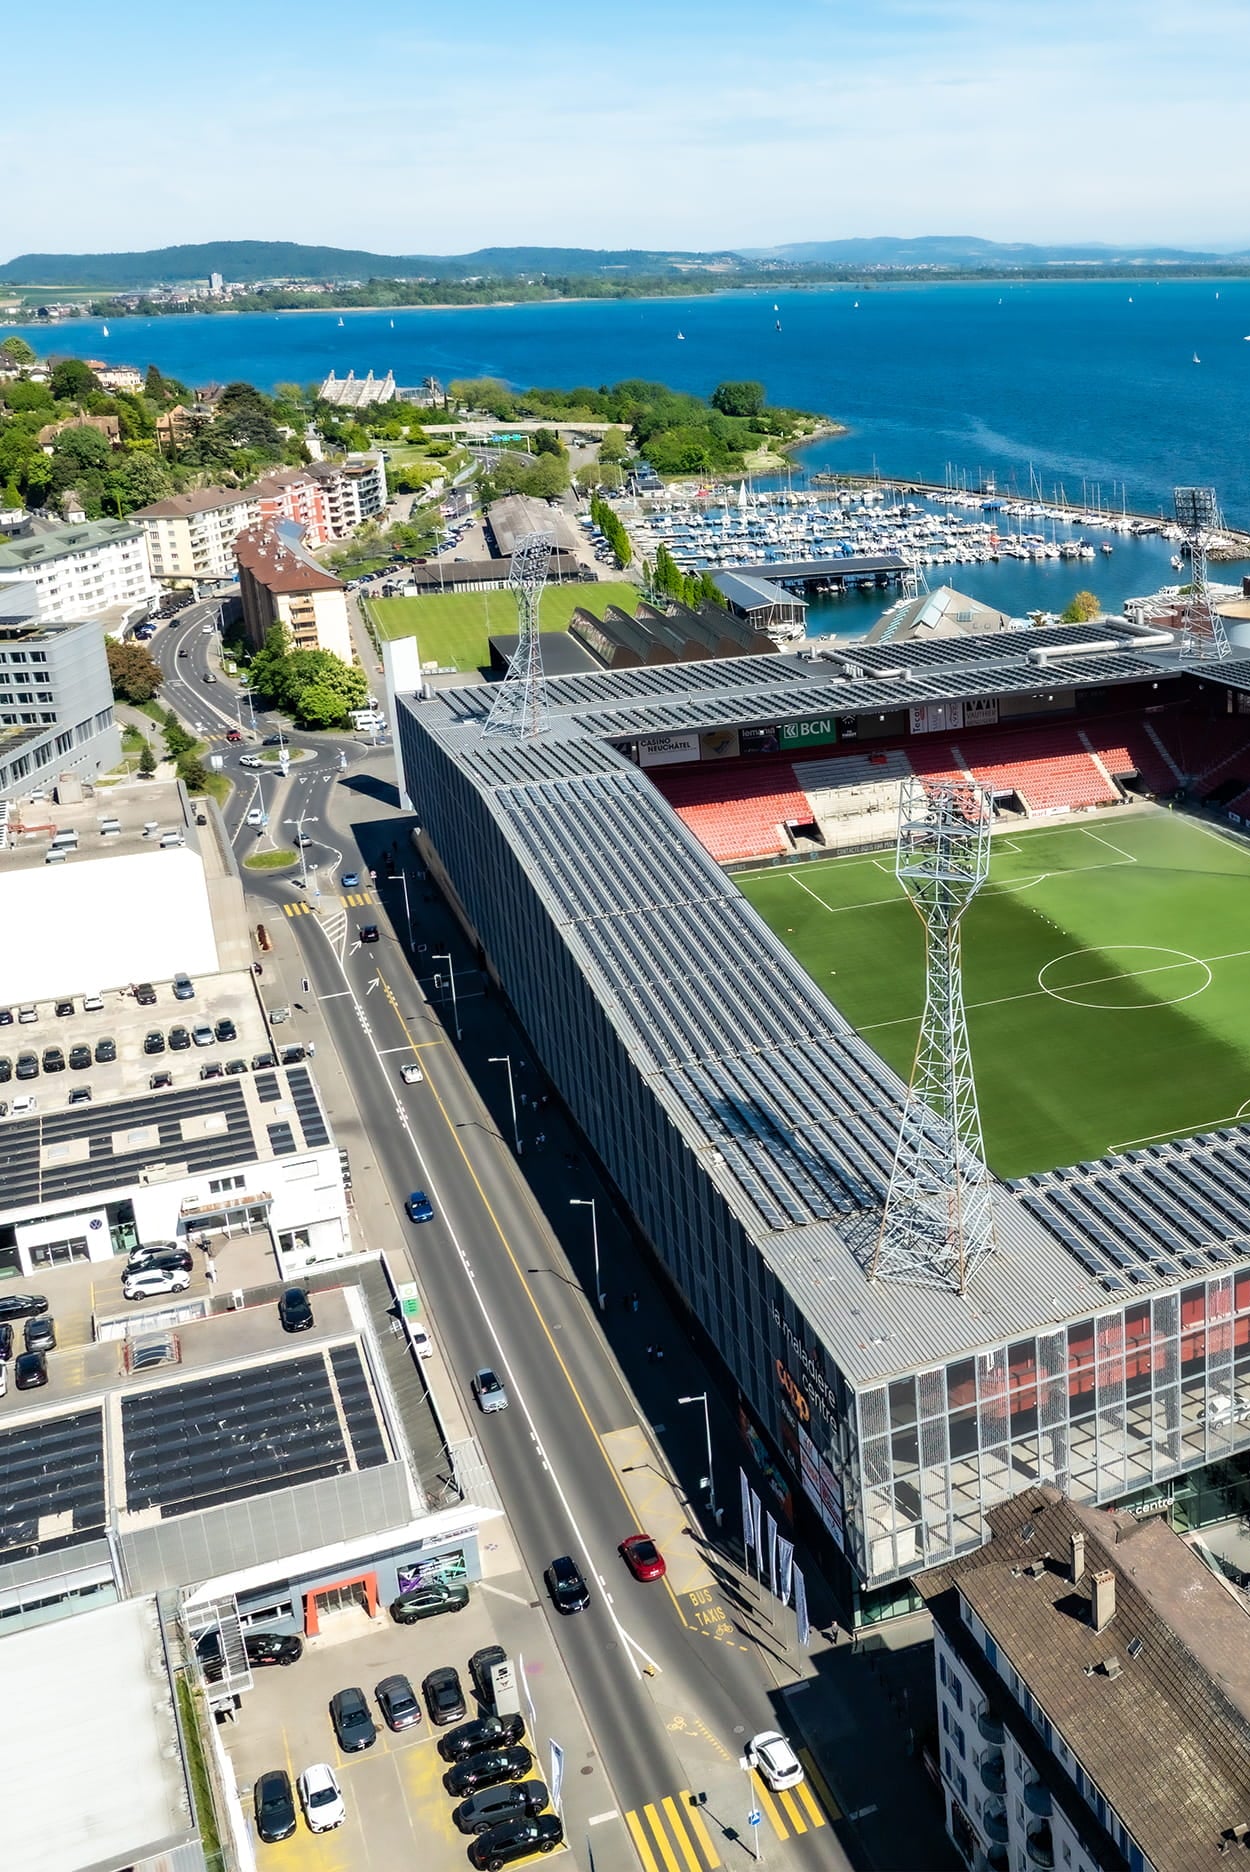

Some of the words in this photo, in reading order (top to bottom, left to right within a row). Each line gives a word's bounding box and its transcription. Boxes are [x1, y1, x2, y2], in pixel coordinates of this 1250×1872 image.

[800, 720, 831, 737] BCN
[640, 737, 671, 747] CASINO
[647, 740, 691, 753] NEUCHÂTEL
[771, 1299, 781, 1329] la
[802, 1373, 838, 1434] centre
[1135, 1497, 1174, 1514] centre
[689, 1589, 713, 1607] BUS
[695, 1606, 726, 1626] TAXIS
